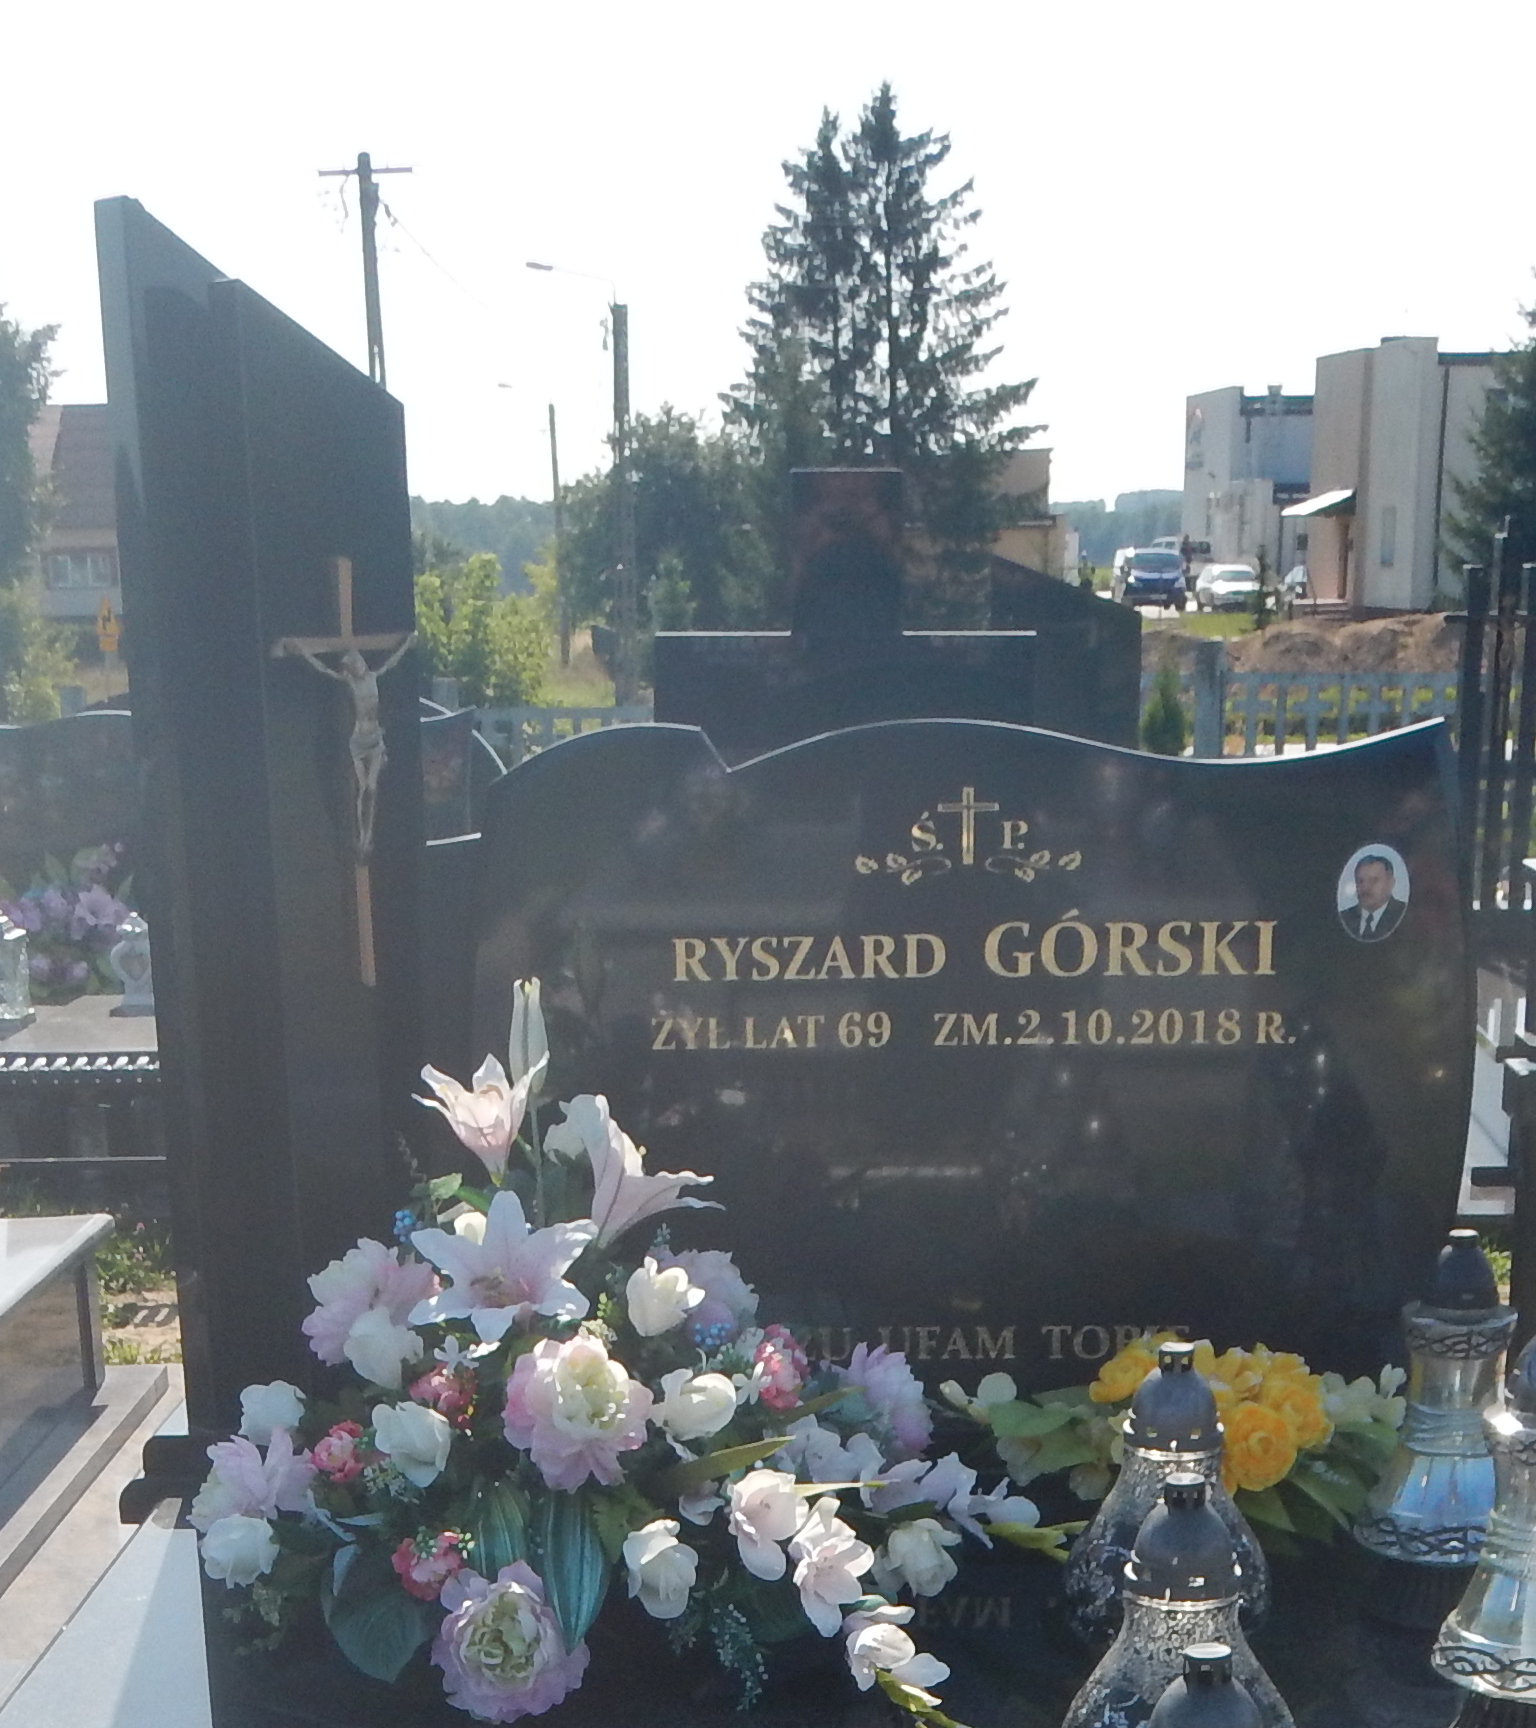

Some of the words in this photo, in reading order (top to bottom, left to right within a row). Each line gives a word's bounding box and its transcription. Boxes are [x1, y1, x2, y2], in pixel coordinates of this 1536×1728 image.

[911, 811, 944, 851] Ś.
[1001, 820, 1029, 850] P.
[672, 933, 947, 983] RYSZARD
[984, 909, 1278, 978] GÓRSKI
[651, 1009, 731, 1050] ŻYŁ
[744, 1014, 825, 1049] LAT
[838, 1010, 891, 1049] 69
[1256, 1010, 1296, 1046] R.
[877, 1324, 1016, 1361] UFAM
